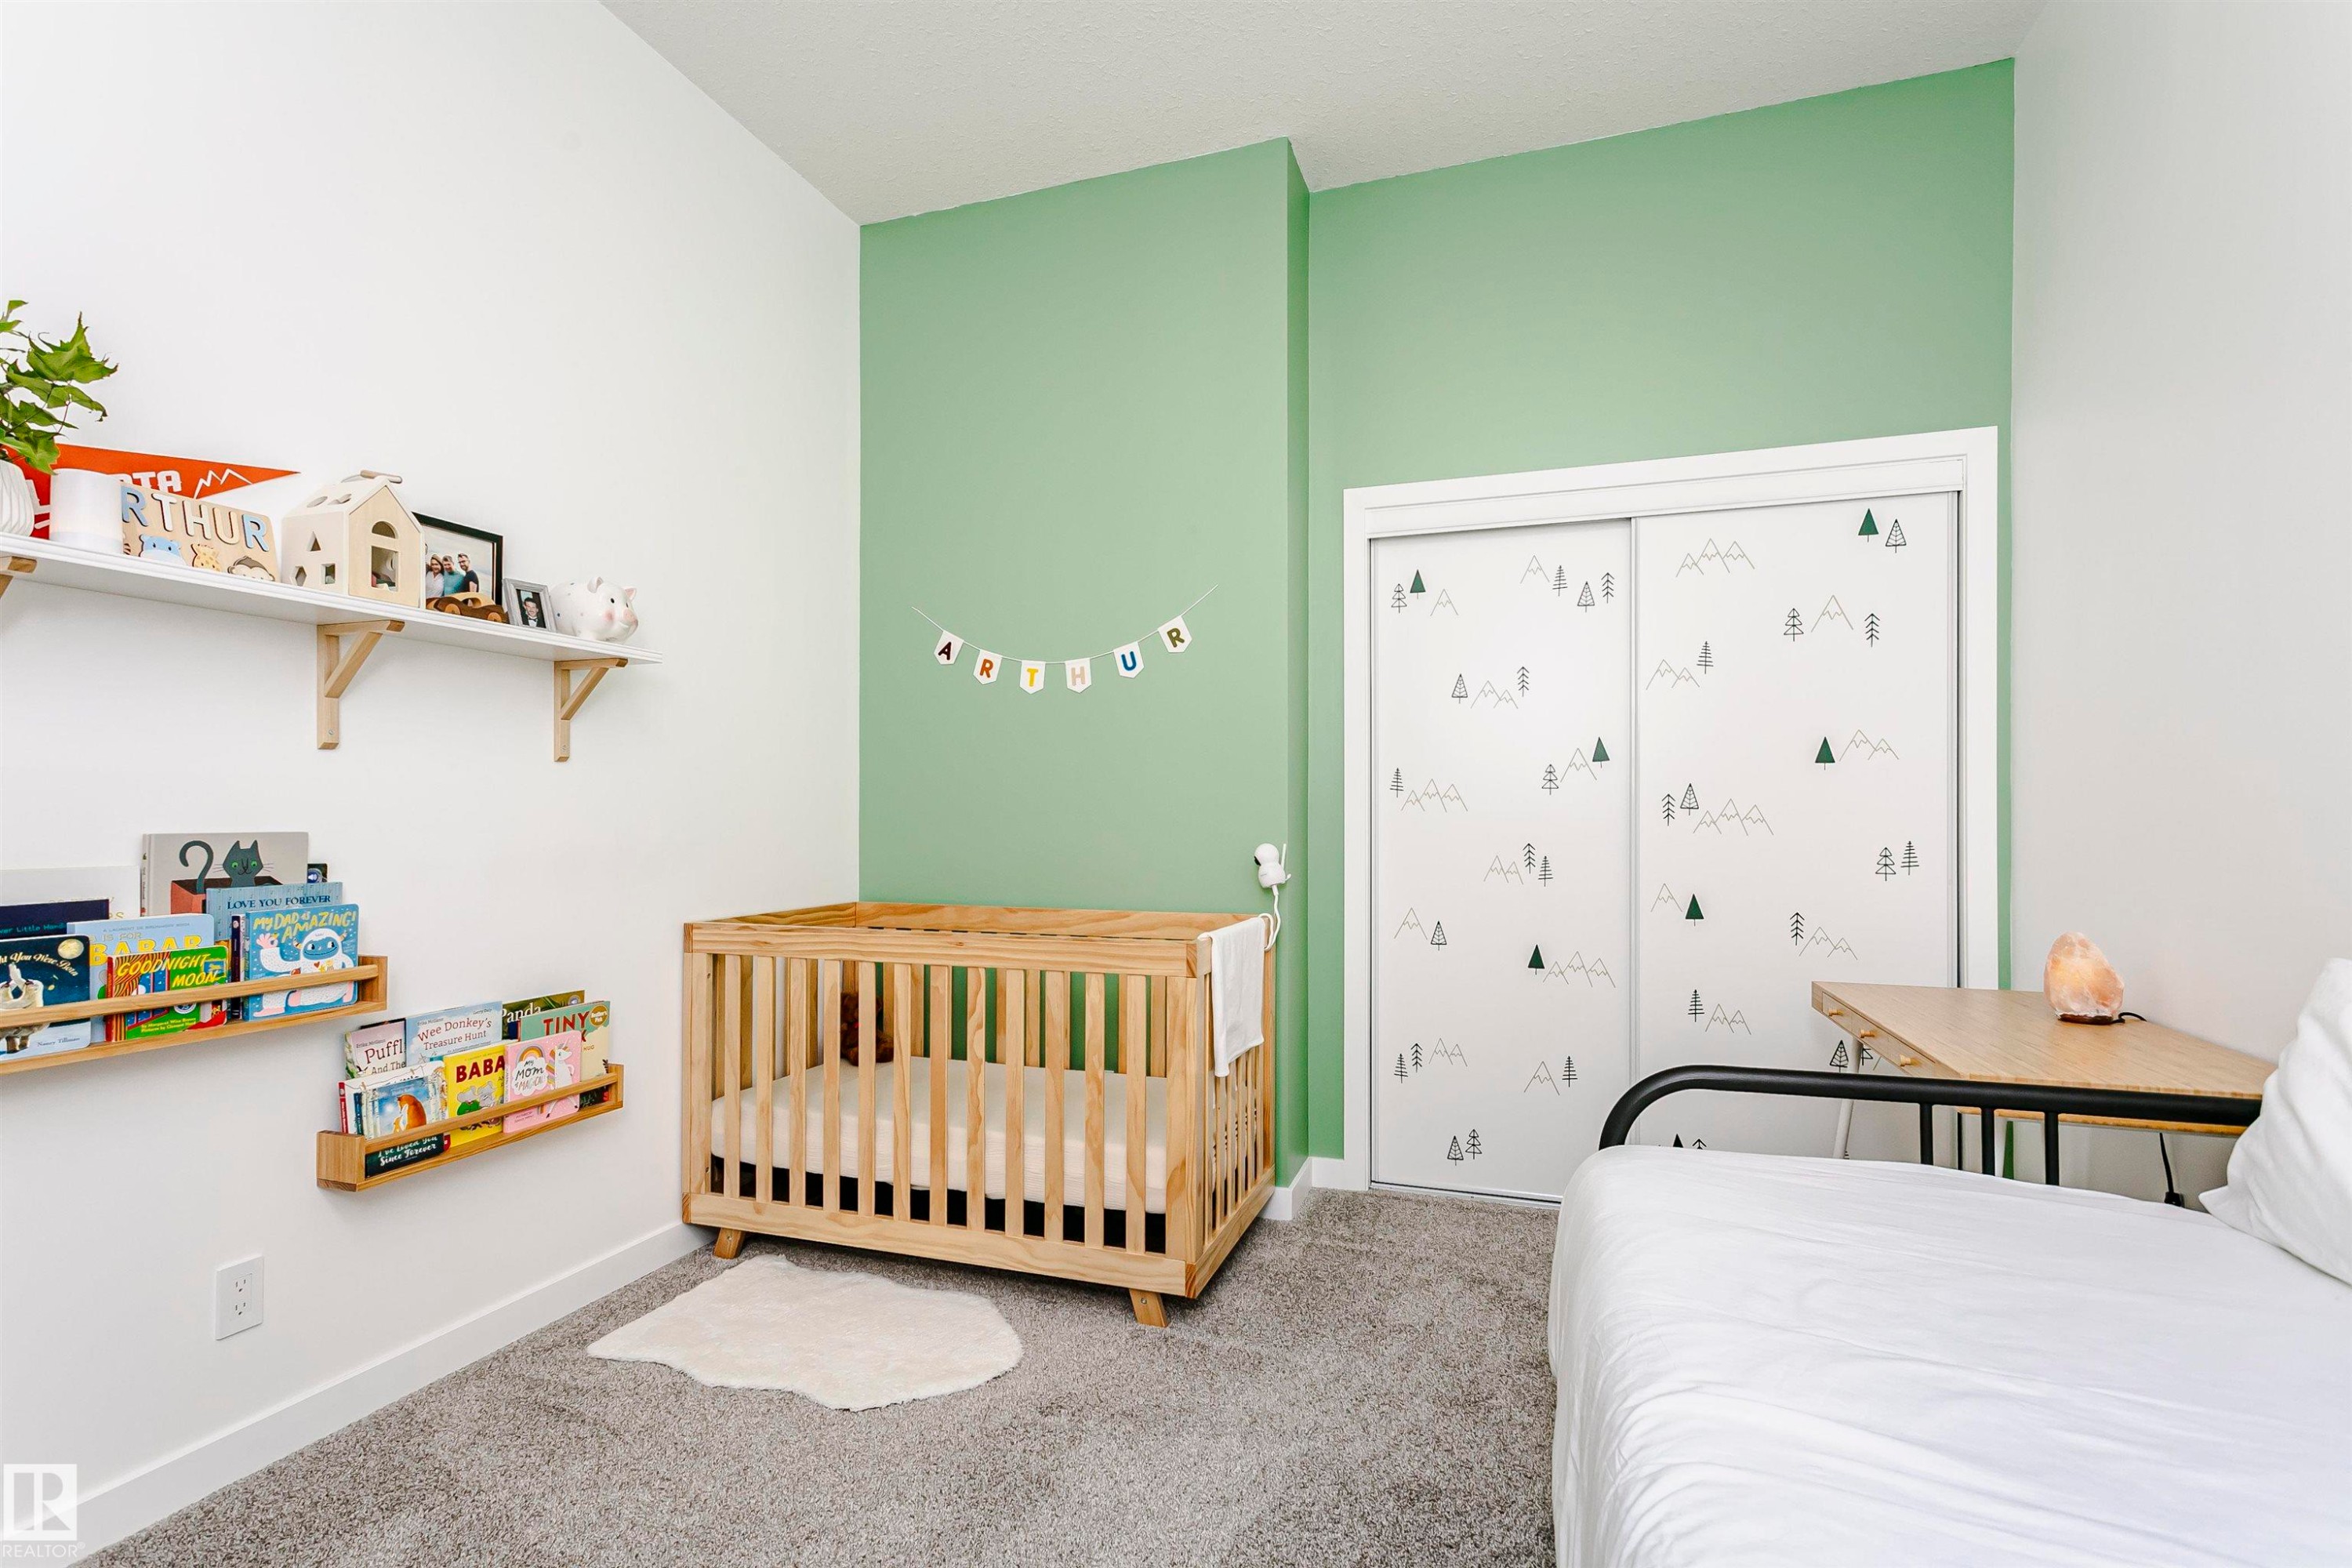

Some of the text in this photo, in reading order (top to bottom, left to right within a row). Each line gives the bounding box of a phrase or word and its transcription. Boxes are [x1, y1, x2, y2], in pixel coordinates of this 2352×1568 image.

[122, 485, 270, 552] RTHUR
[938, 627, 1185, 687] ARTHUR
[227, 895, 331, 909] LOVE YOU FOREVER
[274, 912, 299, 931] DAD
[281, 910, 357, 943] AMAZING!
[118, 953, 212, 977] GOODNIGHT
[172, 970, 220, 988] MOON
[418, 1018, 492, 1042] Wee Donkey's
[543, 1011, 590, 1036] TINY
[365, 1038, 406, 1065] Puffl
[423, 1036, 463, 1051] Treasure
[464, 1030, 487, 1042] Hunt
[372, 1063, 388, 1075] And
[456, 1055, 505, 1083] BABA
[379, 1153, 402, 1167] Since
[404, 1143, 437, 1158] Forever
